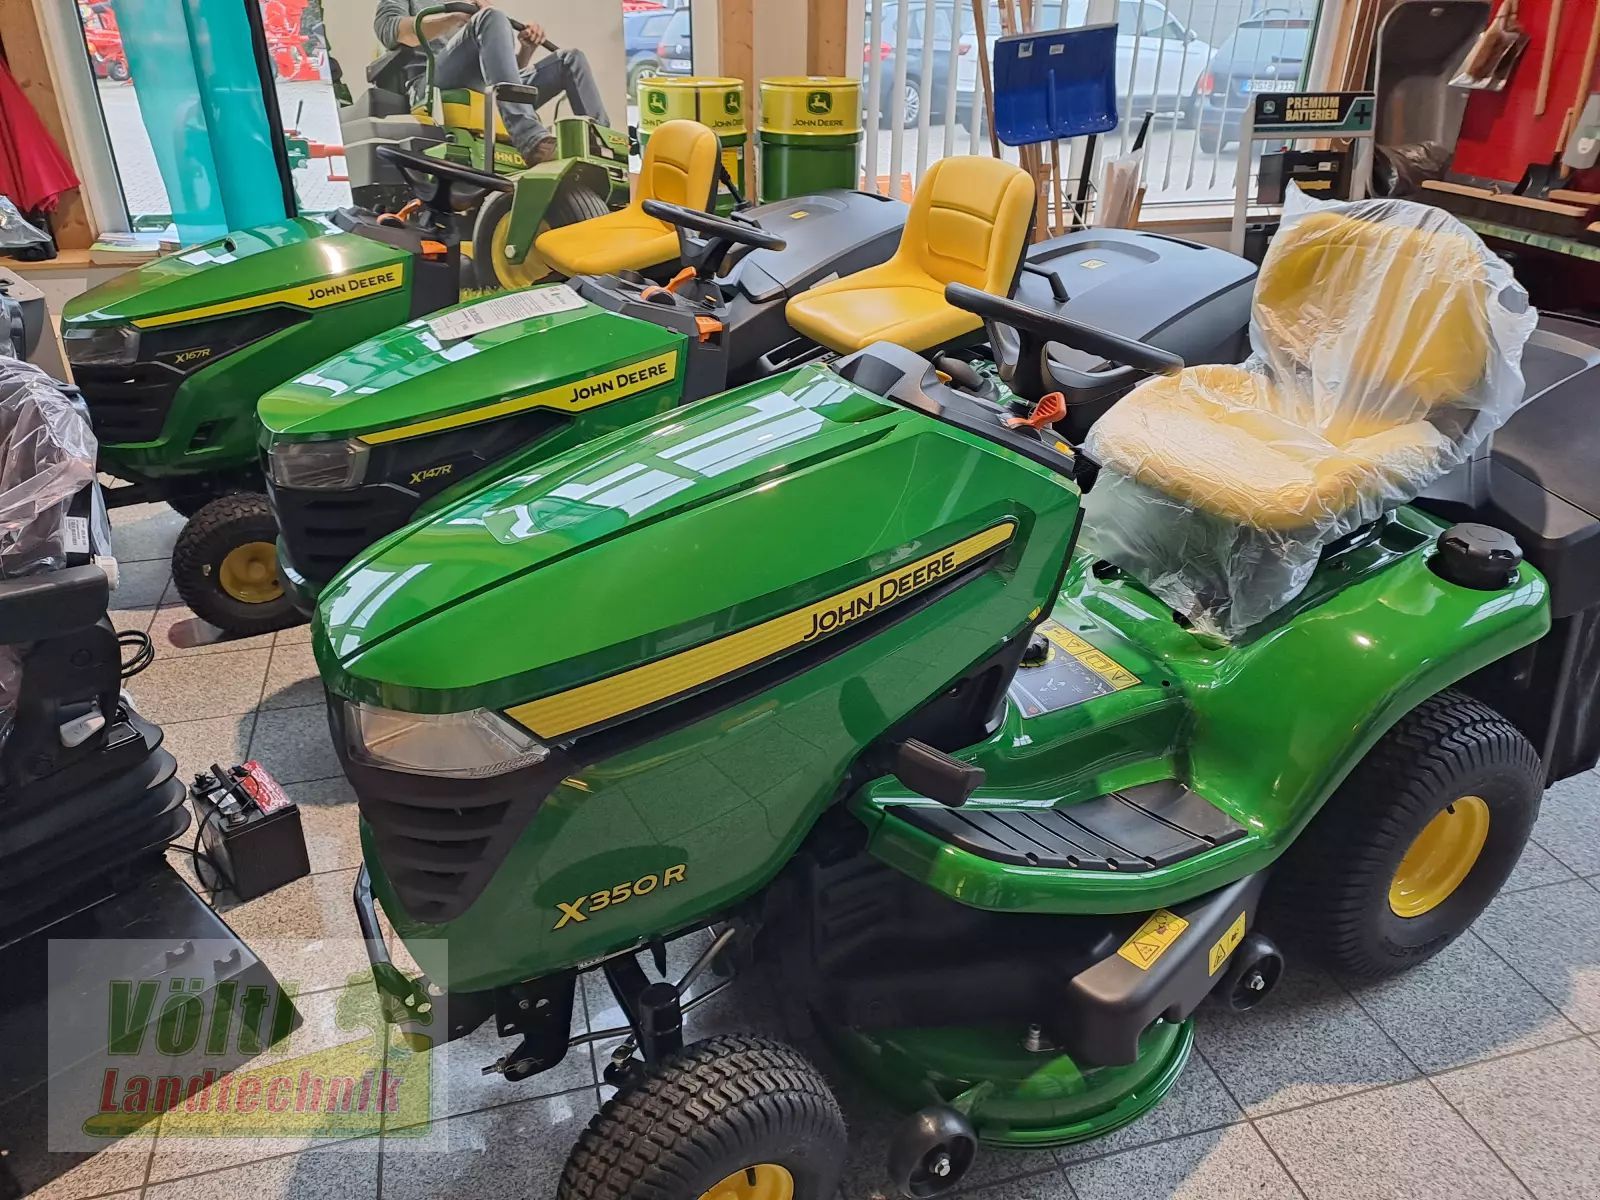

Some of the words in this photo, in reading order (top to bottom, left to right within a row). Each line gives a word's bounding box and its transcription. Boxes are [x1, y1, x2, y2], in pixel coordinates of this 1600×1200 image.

[1286, 96, 1340, 109] PREMIUM
[792, 118, 816, 127] JOHN
[817, 119, 844, 127] DEERE
[1285, 109, 1339, 121] BATTERIEN
[711, 119, 732, 128] JOHN
[307, 285, 347, 301] JOHN
[348, 272, 395, 291] DEERE
[174, 348, 211, 364] X167R
[569, 380, 614, 403] JOHN
[616, 362, 668, 389] DEERE
[408, 463, 453, 485] X147R
[803, 591, 873, 640] JOHN
[879, 551, 955, 604] DEERE
